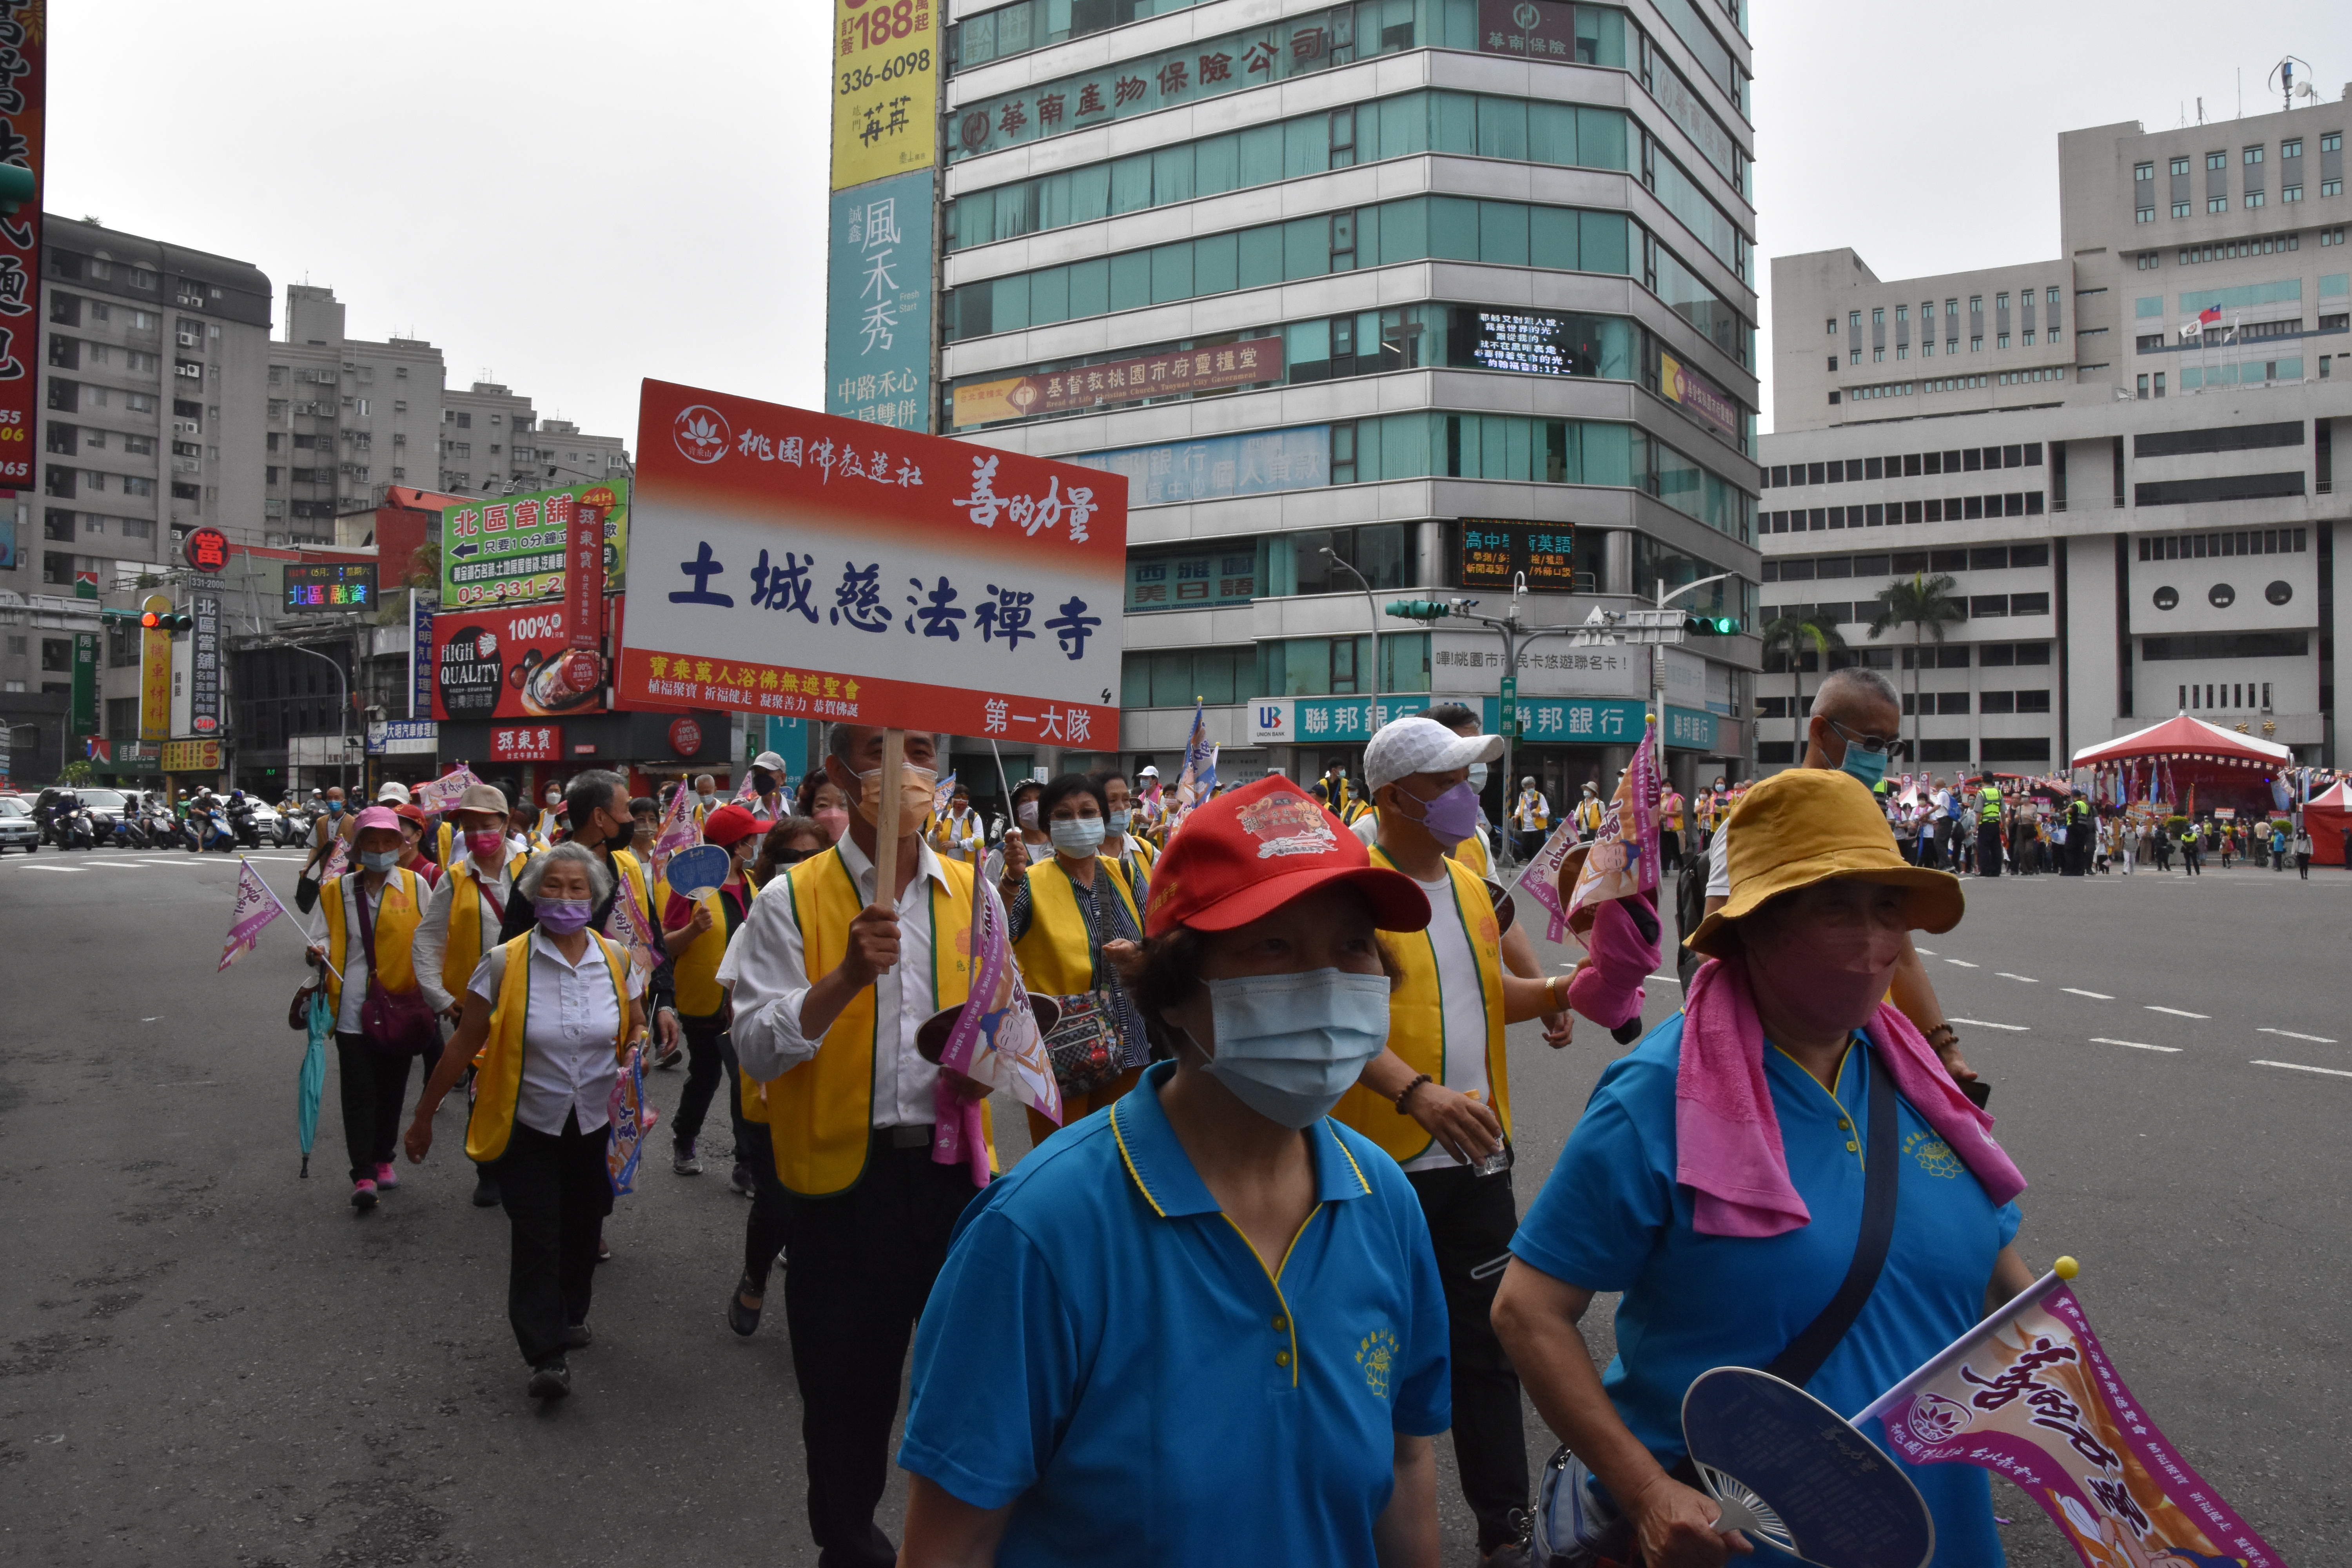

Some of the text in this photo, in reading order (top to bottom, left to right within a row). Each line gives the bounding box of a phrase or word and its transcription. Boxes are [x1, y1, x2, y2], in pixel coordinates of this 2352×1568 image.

[841, 17, 855, 56] 訂簽
[854, 0, 913, 50] 188
[1488, 31, 1566, 55] 華南保險
[840, 49, 930, 95] 336-6098
[998, 27, 1324, 137] 華南產物保險公司
[848, 205, 862, 243] 誠鑫
[860, 198, 900, 356] 風禾秀
[900, 289, 919, 301] Fresh
[899, 303, 916, 313] Start
[839, 367, 917, 404] 中路禾心
[1046, 399, 1066, 408] Bread
[1096, 390, 1127, 399] Christian
[1161, 381, 1190, 390] Taoyuan
[1194, 378, 1208, 386] City
[1212, 372, 1256, 383] Government
[1047, 347, 1257, 398] 基督教桃園市府靈糧堂
[738, 429, 923, 487] 桃園佛教蓮社
[453, 492, 573, 538] 北區當舖
[583, 492, 612, 504] 24H
[953, 455, 1098, 544] 善的力量
[196, 532, 224, 565] 當
[191, 578, 225, 588] 331-2000
[289, 583, 367, 605] 北區 融資
[668, 541, 1102, 661] 土城慈法禪寺
[197, 599, 216, 670] 北區當舖
[508, 615, 552, 641] 100%
[79, 635, 91, 662] 房屋
[441, 642, 474, 662] HIGH
[574, 662, 592, 671] 100%
[440, 663, 501, 685] QUALITY
[650, 655, 861, 701] 寶乘萬人浴佛無遮聖會
[648, 679, 859, 718] 植福聚寶 祈福健走 凝聚善力 恭賀佛誕
[1503, 688, 1513, 730] 縣府路
[197, 719, 215, 729] 24H
[984, 698, 1092, 742] 第一大隊
[2212, 719, 2276, 735] 政府
